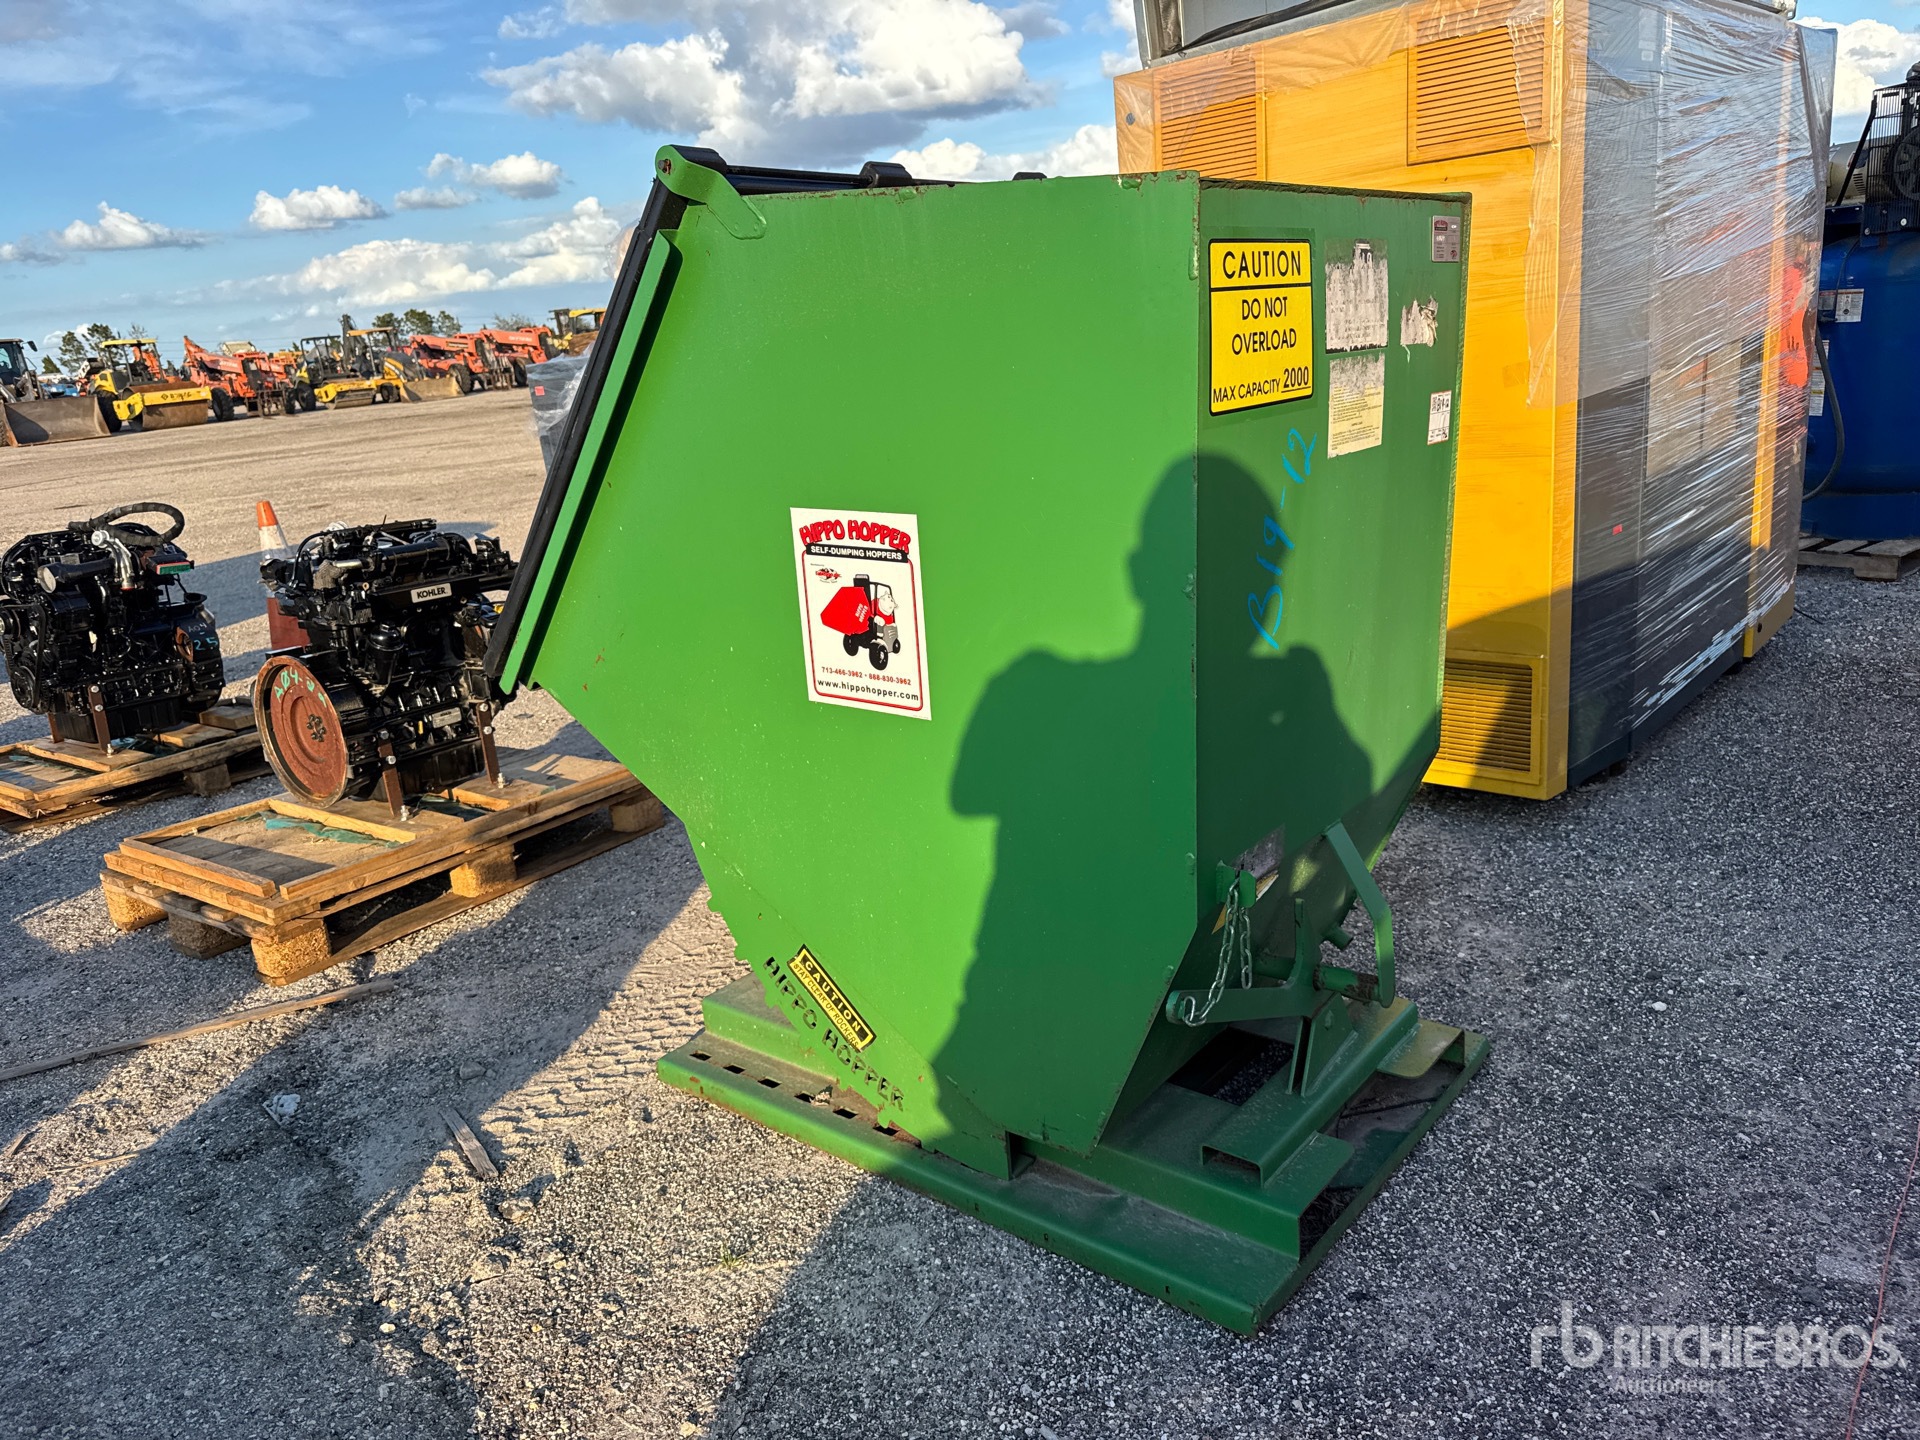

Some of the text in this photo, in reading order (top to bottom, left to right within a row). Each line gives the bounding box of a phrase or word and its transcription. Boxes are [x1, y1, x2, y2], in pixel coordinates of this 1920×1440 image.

[1222, 250, 1302, 279] CAUTION
[1241, 296, 1288, 320] DO NOT
[1231, 327, 1297, 356] OVERLOAD
[1213, 366, 1310, 404] MAX CAPACITY 2000
[799, 519, 911, 555] HIPPO HOPPER
[810, 545, 903, 561] SELF-DUMPING HOPPERS
[416, 587, 446, 600] KOHLER
[821, 666, 863, 679] 713-466-3962
[817, 679, 919, 701] www.hippohopper.com
[793, 963, 859, 1047] STAY CLEAR OF ROCKERS
[805, 961, 861, 1032] CAUTION
[763, 956, 905, 1112] HIPPO HOPPER
